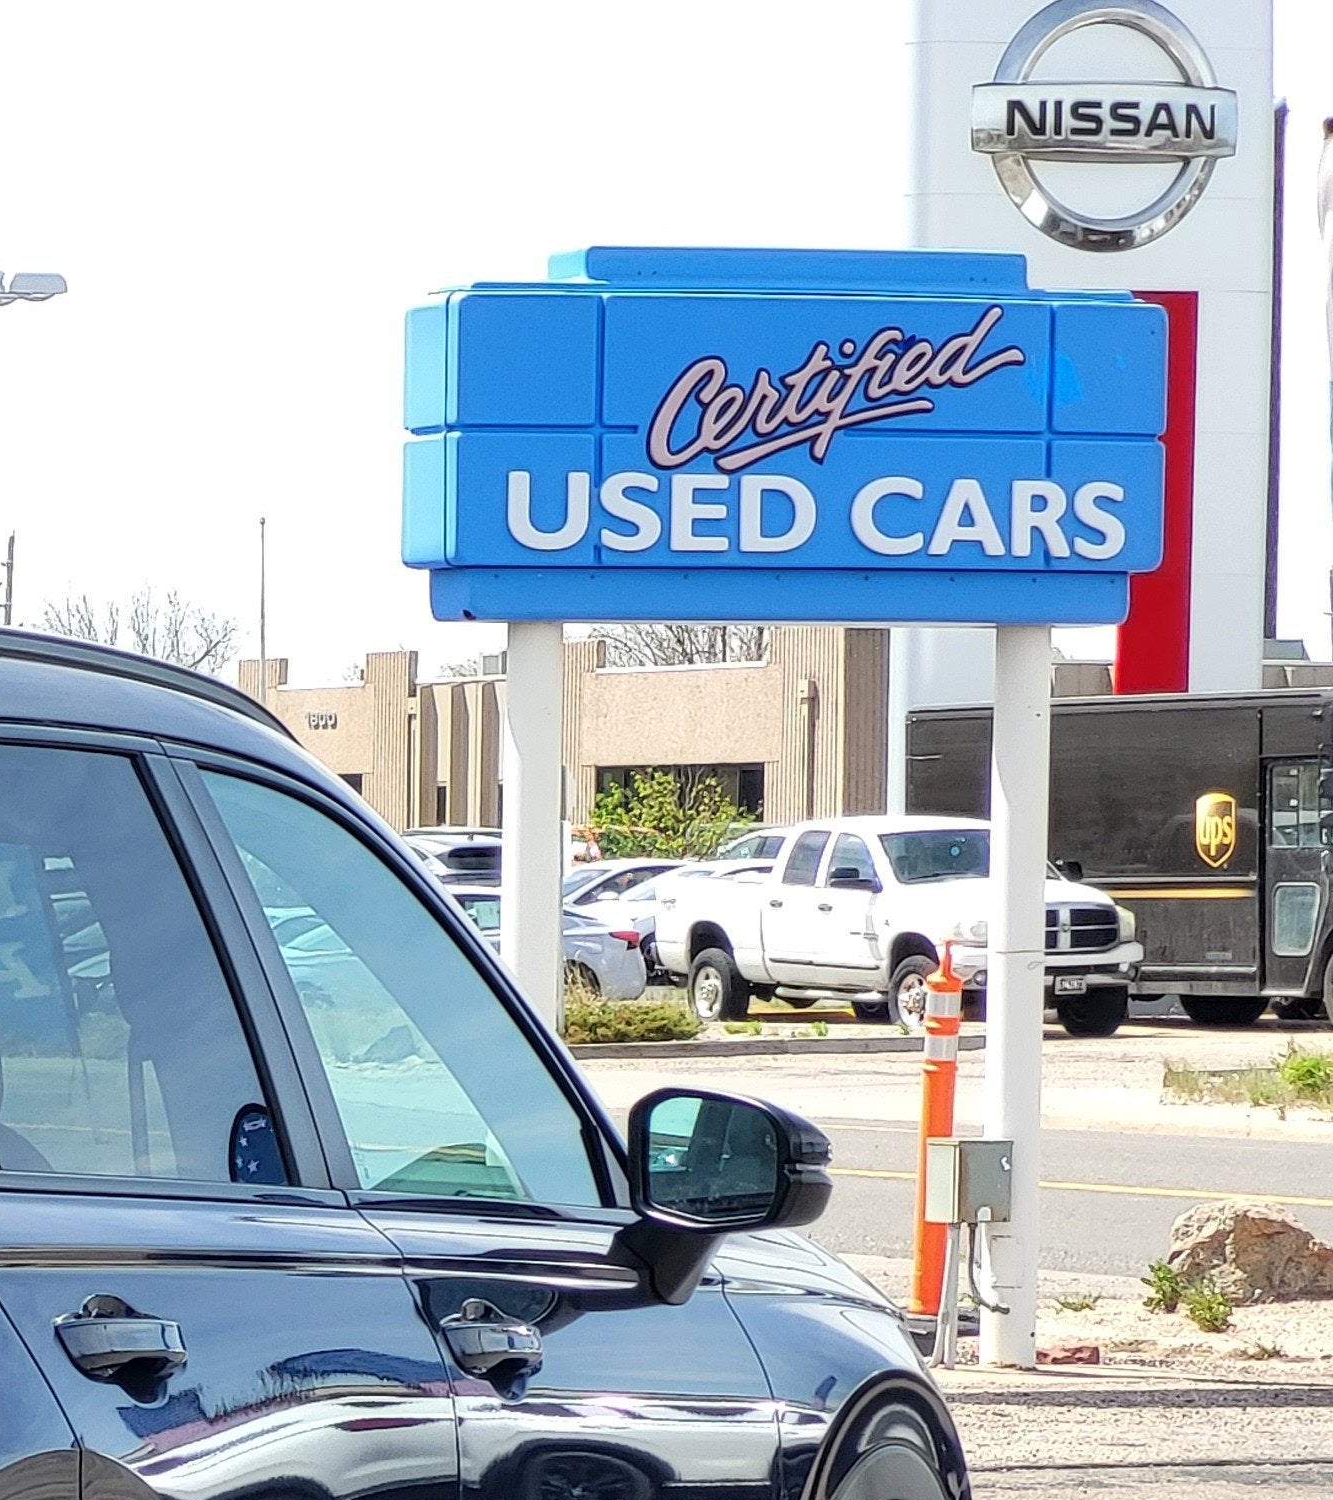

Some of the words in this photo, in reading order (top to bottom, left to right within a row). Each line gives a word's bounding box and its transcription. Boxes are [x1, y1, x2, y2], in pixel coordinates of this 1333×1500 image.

[1006, 98, 1218, 142] NISSAN
[647, 304, 1026, 475] Certified
[505, 470, 817, 553] USED
[851, 478, 1127, 561] CARS
